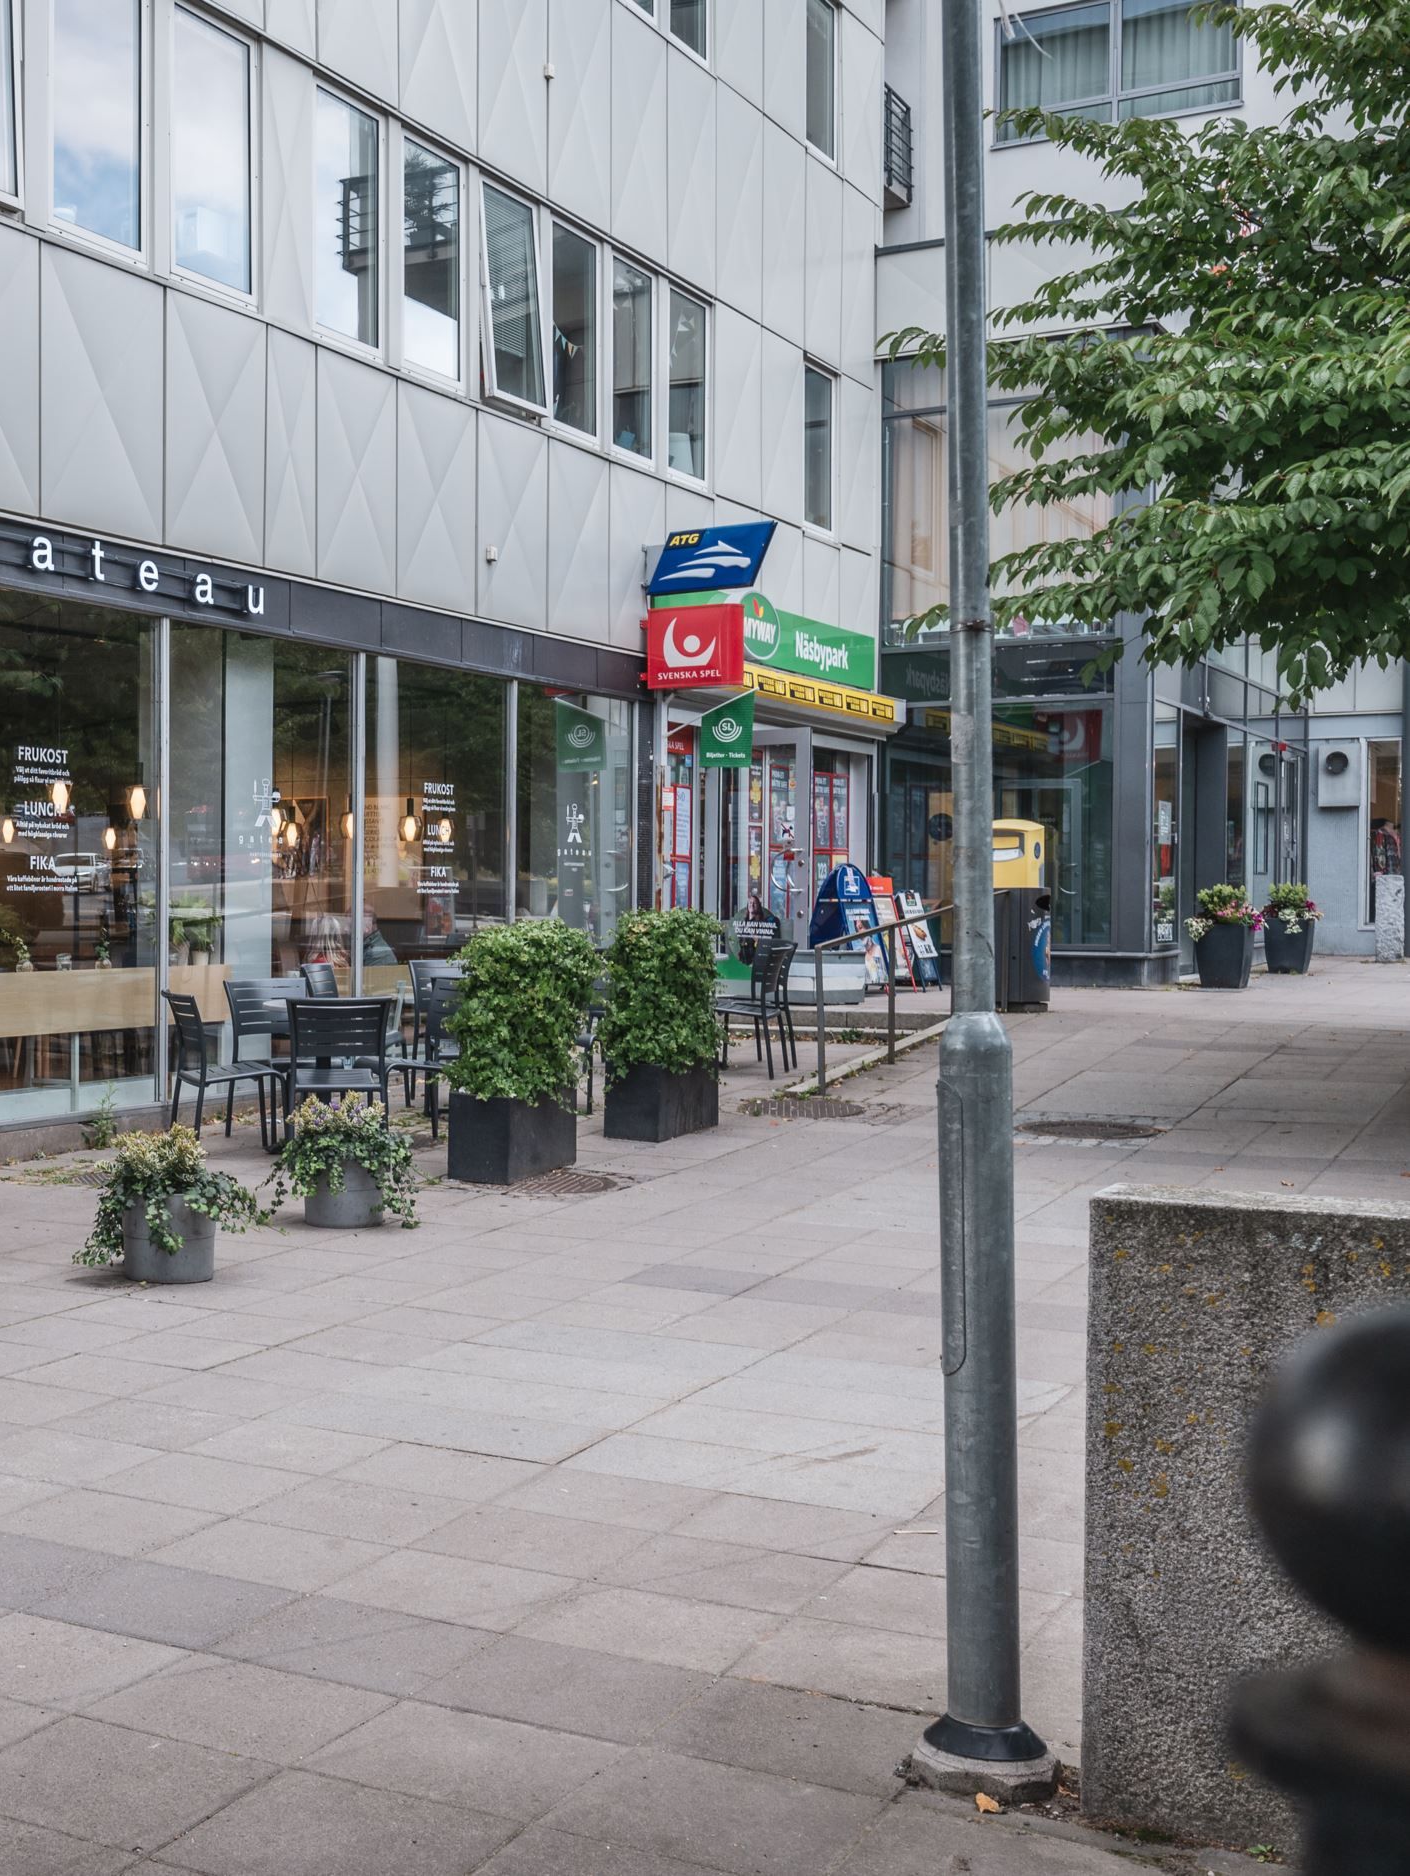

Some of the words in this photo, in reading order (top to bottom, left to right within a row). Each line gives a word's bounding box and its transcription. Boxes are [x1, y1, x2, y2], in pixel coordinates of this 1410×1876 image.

[669, 533, 700, 547] ATG
[744, 616, 776, 645] MYWAY
[795, 630, 849, 672] Näsbypark
[657, 671, 698, 680] SVENSKA
[700, 669, 722, 678] SPEL
[721, 722, 732, 731] SL
[18, 746, 68, 764] FRUKOST
[424, 782, 454, 795] FRUKOST
[24, 801, 62, 816] LUNCH
[30, 855, 56, 870] FIKA
[430, 866, 447, 878] FIKA
